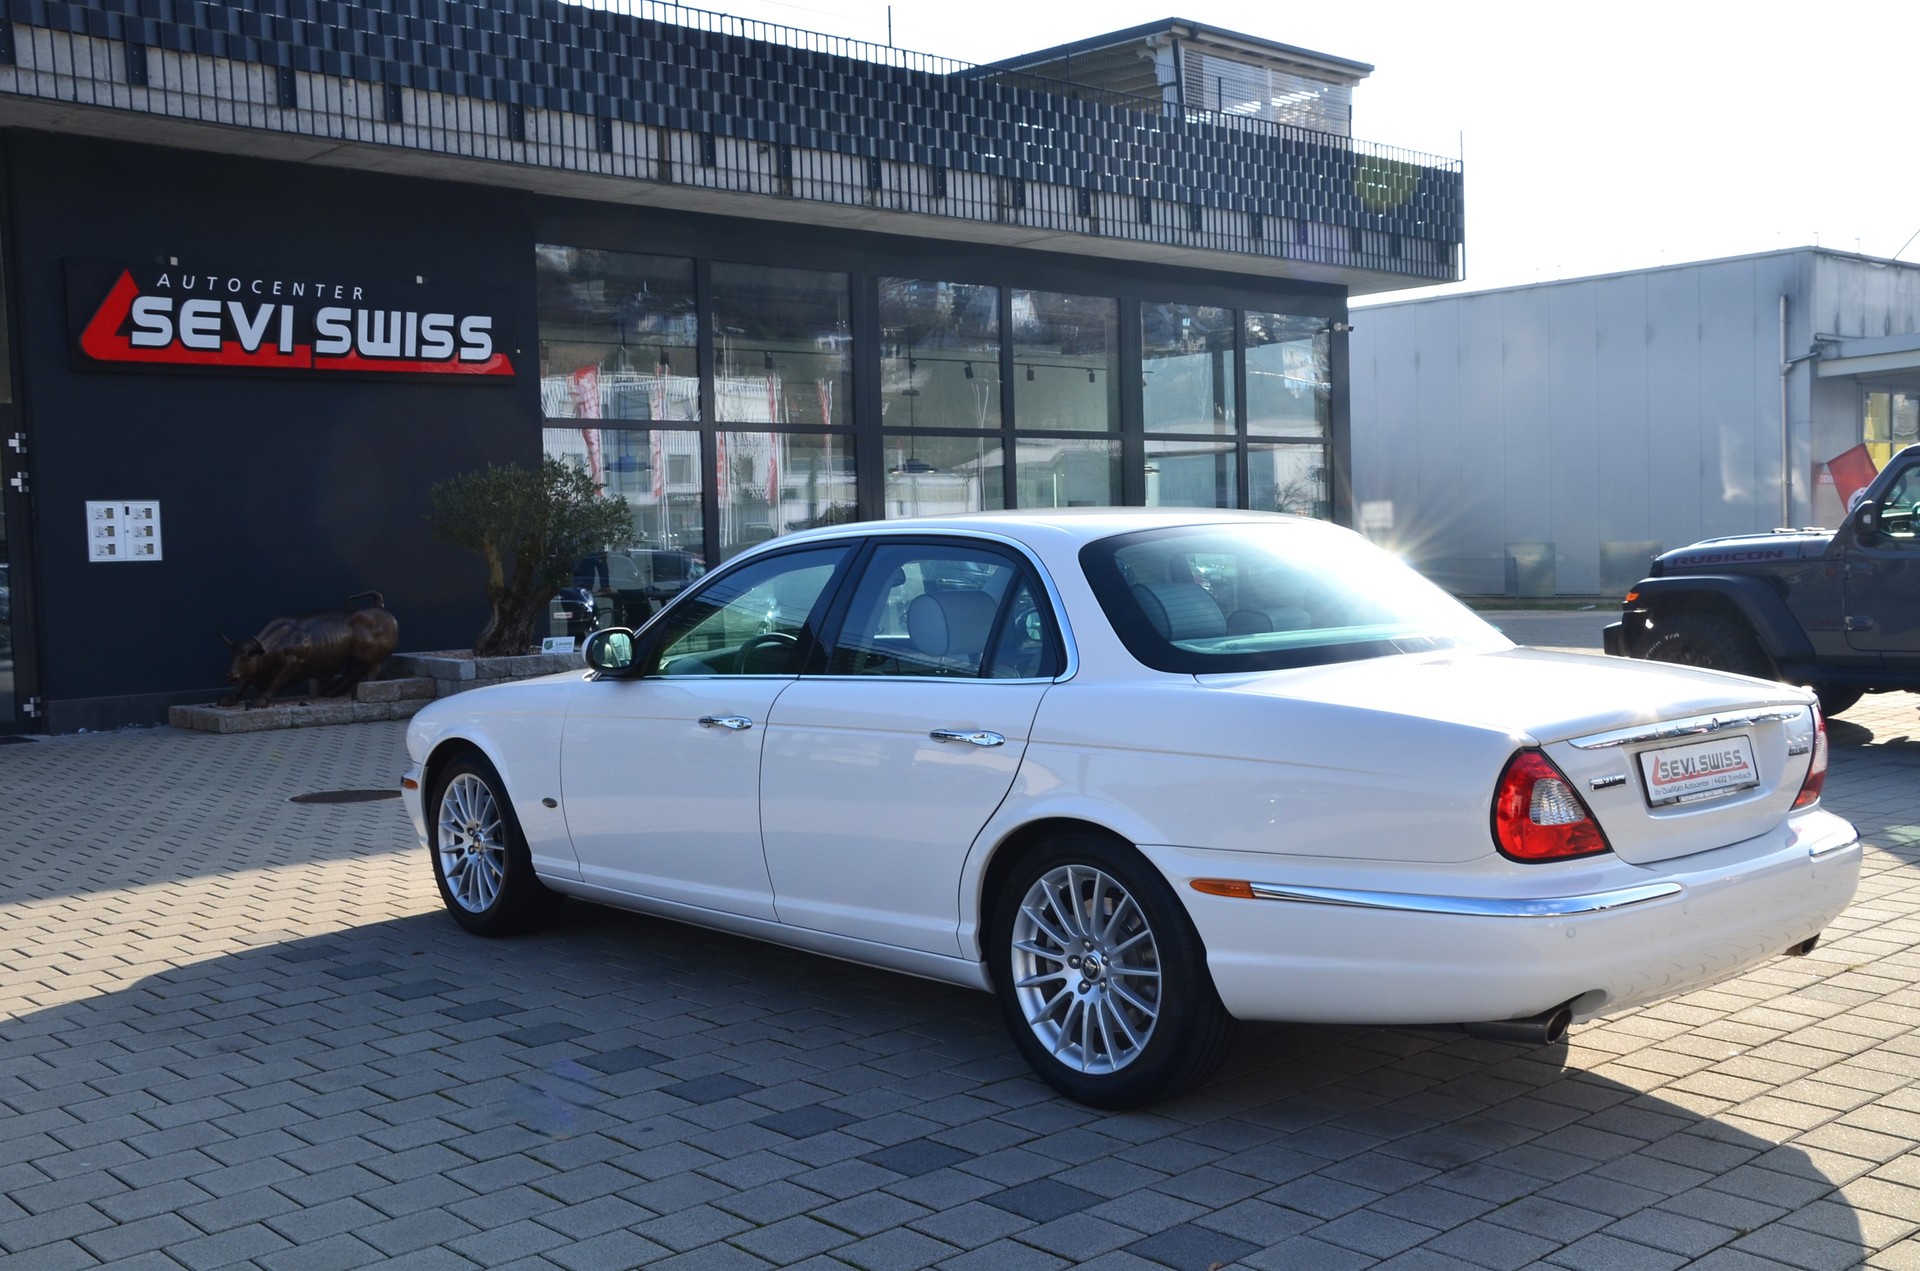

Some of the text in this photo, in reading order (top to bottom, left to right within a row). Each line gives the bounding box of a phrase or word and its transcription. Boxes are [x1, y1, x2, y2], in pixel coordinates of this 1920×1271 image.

[156, 272, 363, 301] AUTOCENTER
[130, 295, 493, 361] SEVI SWISS
[1672, 550, 1784, 566] RUBICON
[1660, 749, 1742, 779] SEVI SWISS
